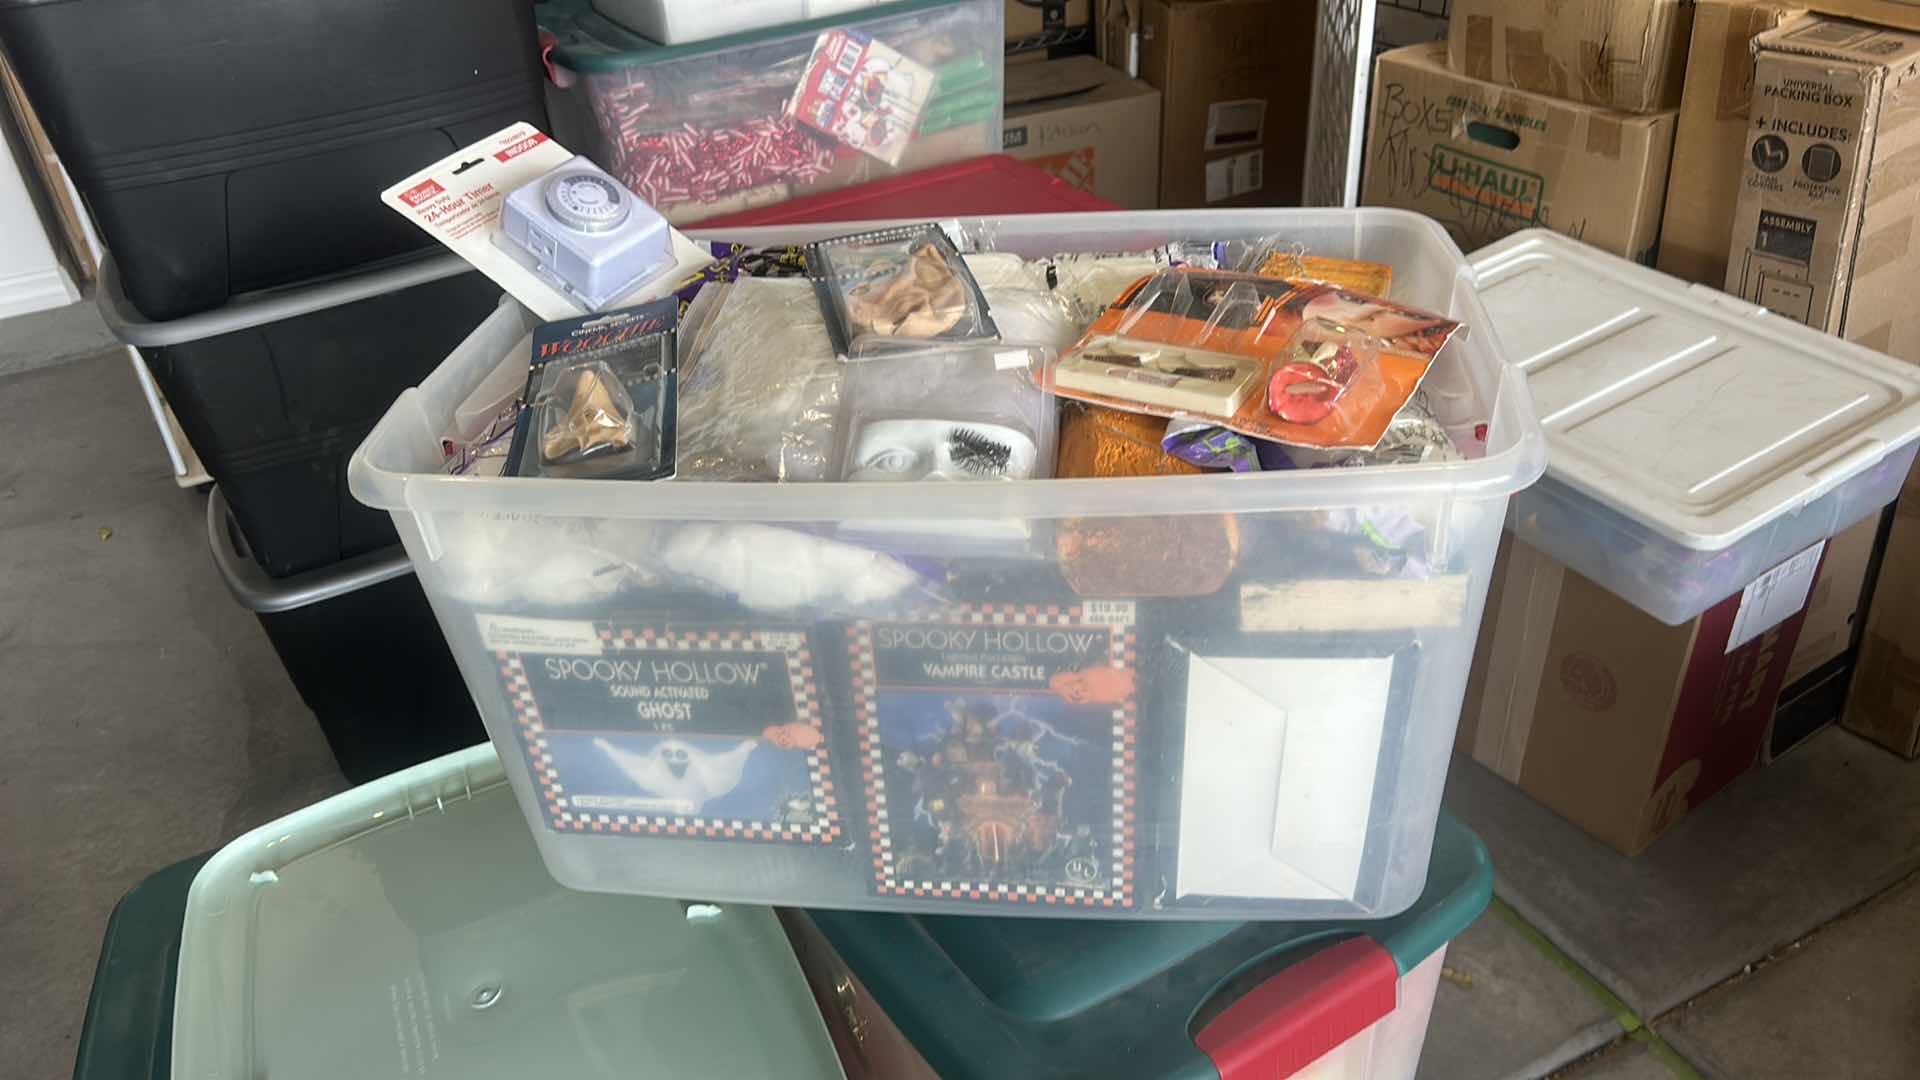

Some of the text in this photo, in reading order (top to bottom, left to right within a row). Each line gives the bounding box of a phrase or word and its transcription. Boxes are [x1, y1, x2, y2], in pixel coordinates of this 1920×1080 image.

[1783, 78, 1833, 94] UNIVERSAL
[1764, 85, 1853, 108] PACKING BOX
[424, 199, 466, 222] 24-Hour
[465, 183, 493, 200] Timer
[1761, 215, 1814, 234] ASSEMBLY
[879, 628, 1094, 653] SPOOKY HOLLOW
[545, 658, 760, 685] SPOOKY HOLLOW
[923, 664, 1045, 681] VAMPIRE CASTLE
[610, 685, 709, 699] SOUND ACTIVATED
[637, 703, 693, 720] GHOST
